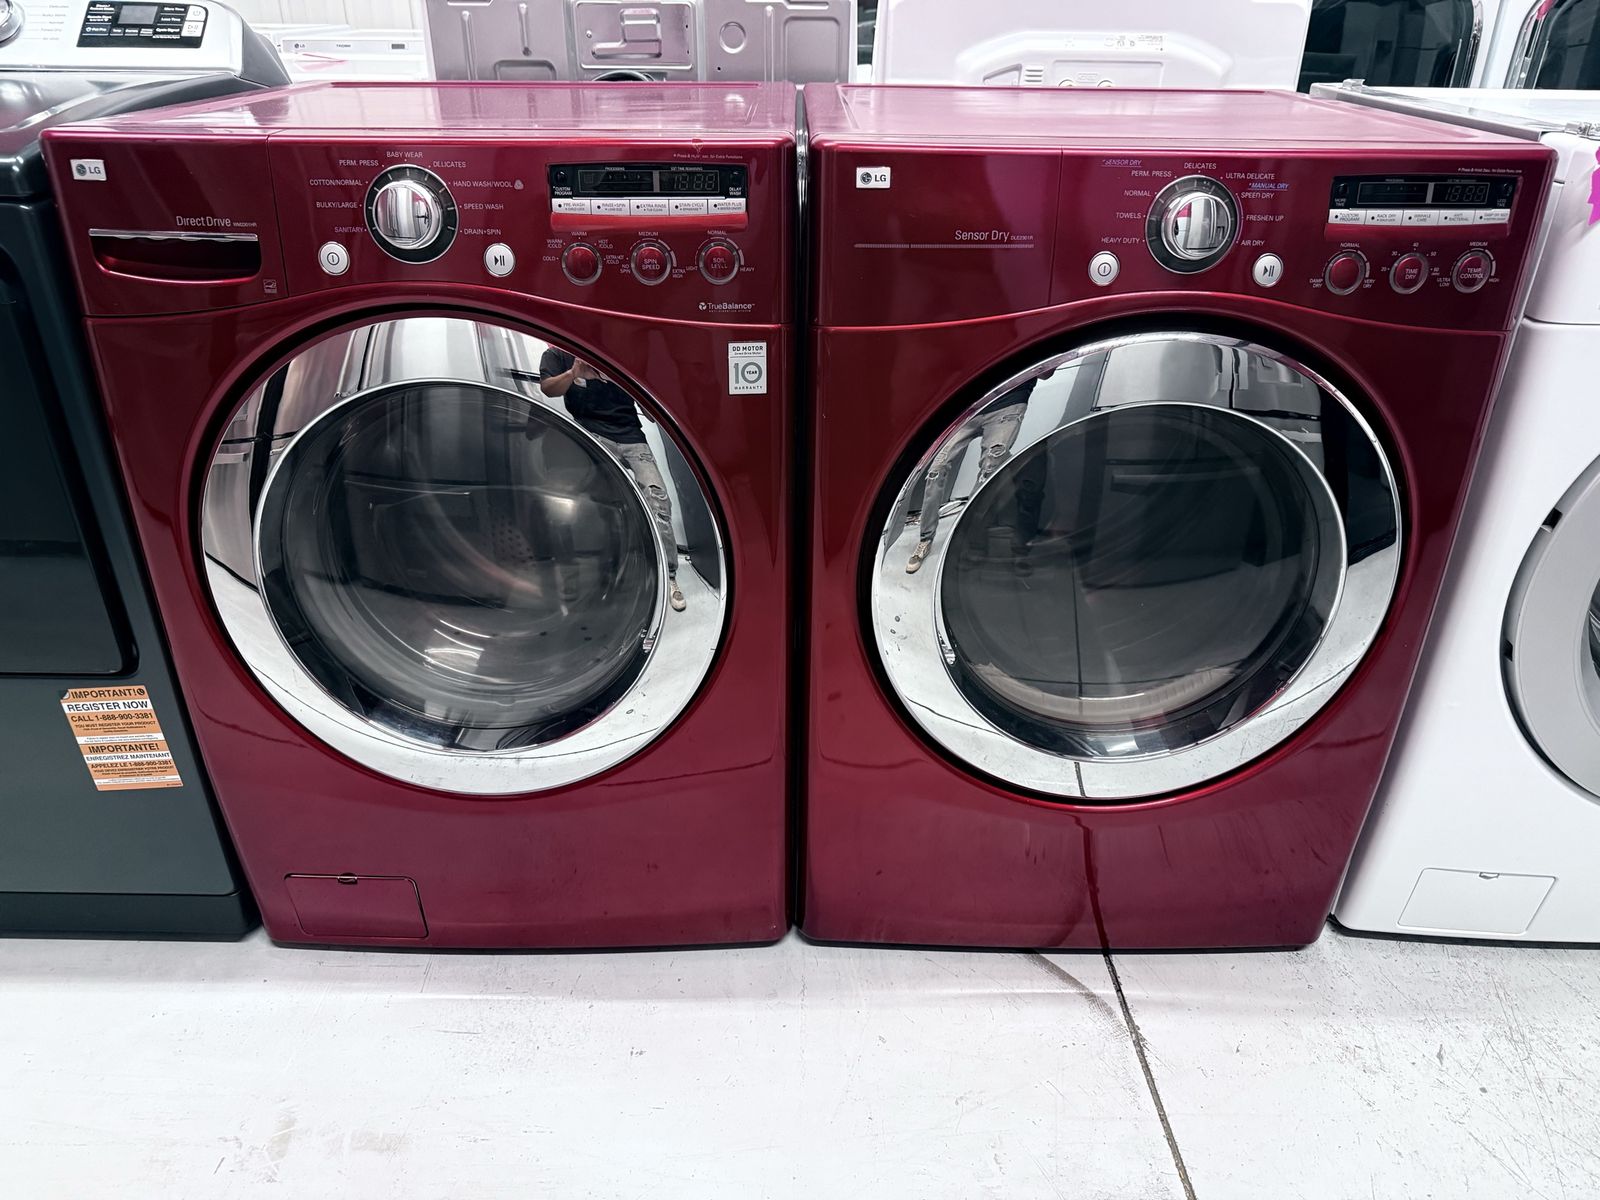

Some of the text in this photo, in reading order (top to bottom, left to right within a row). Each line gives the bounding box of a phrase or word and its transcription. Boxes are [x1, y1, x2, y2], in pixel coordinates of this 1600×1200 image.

[89, 166, 101, 175] LG
[874, 174, 887, 182] LG
[176, 216, 205, 226] Direct
[206, 216, 231, 227] Drive
[954, 230, 989, 241] Sensor
[991, 230, 1010, 243] Dry
[734, 362, 762, 384] 10
[71, 688, 136, 699] IMPORTANT!
[67, 701, 148, 712] REGISTER NOW
[95, 712, 153, 721] 1-888-900-3381
[89, 743, 159, 754] IMPORTANTE!
